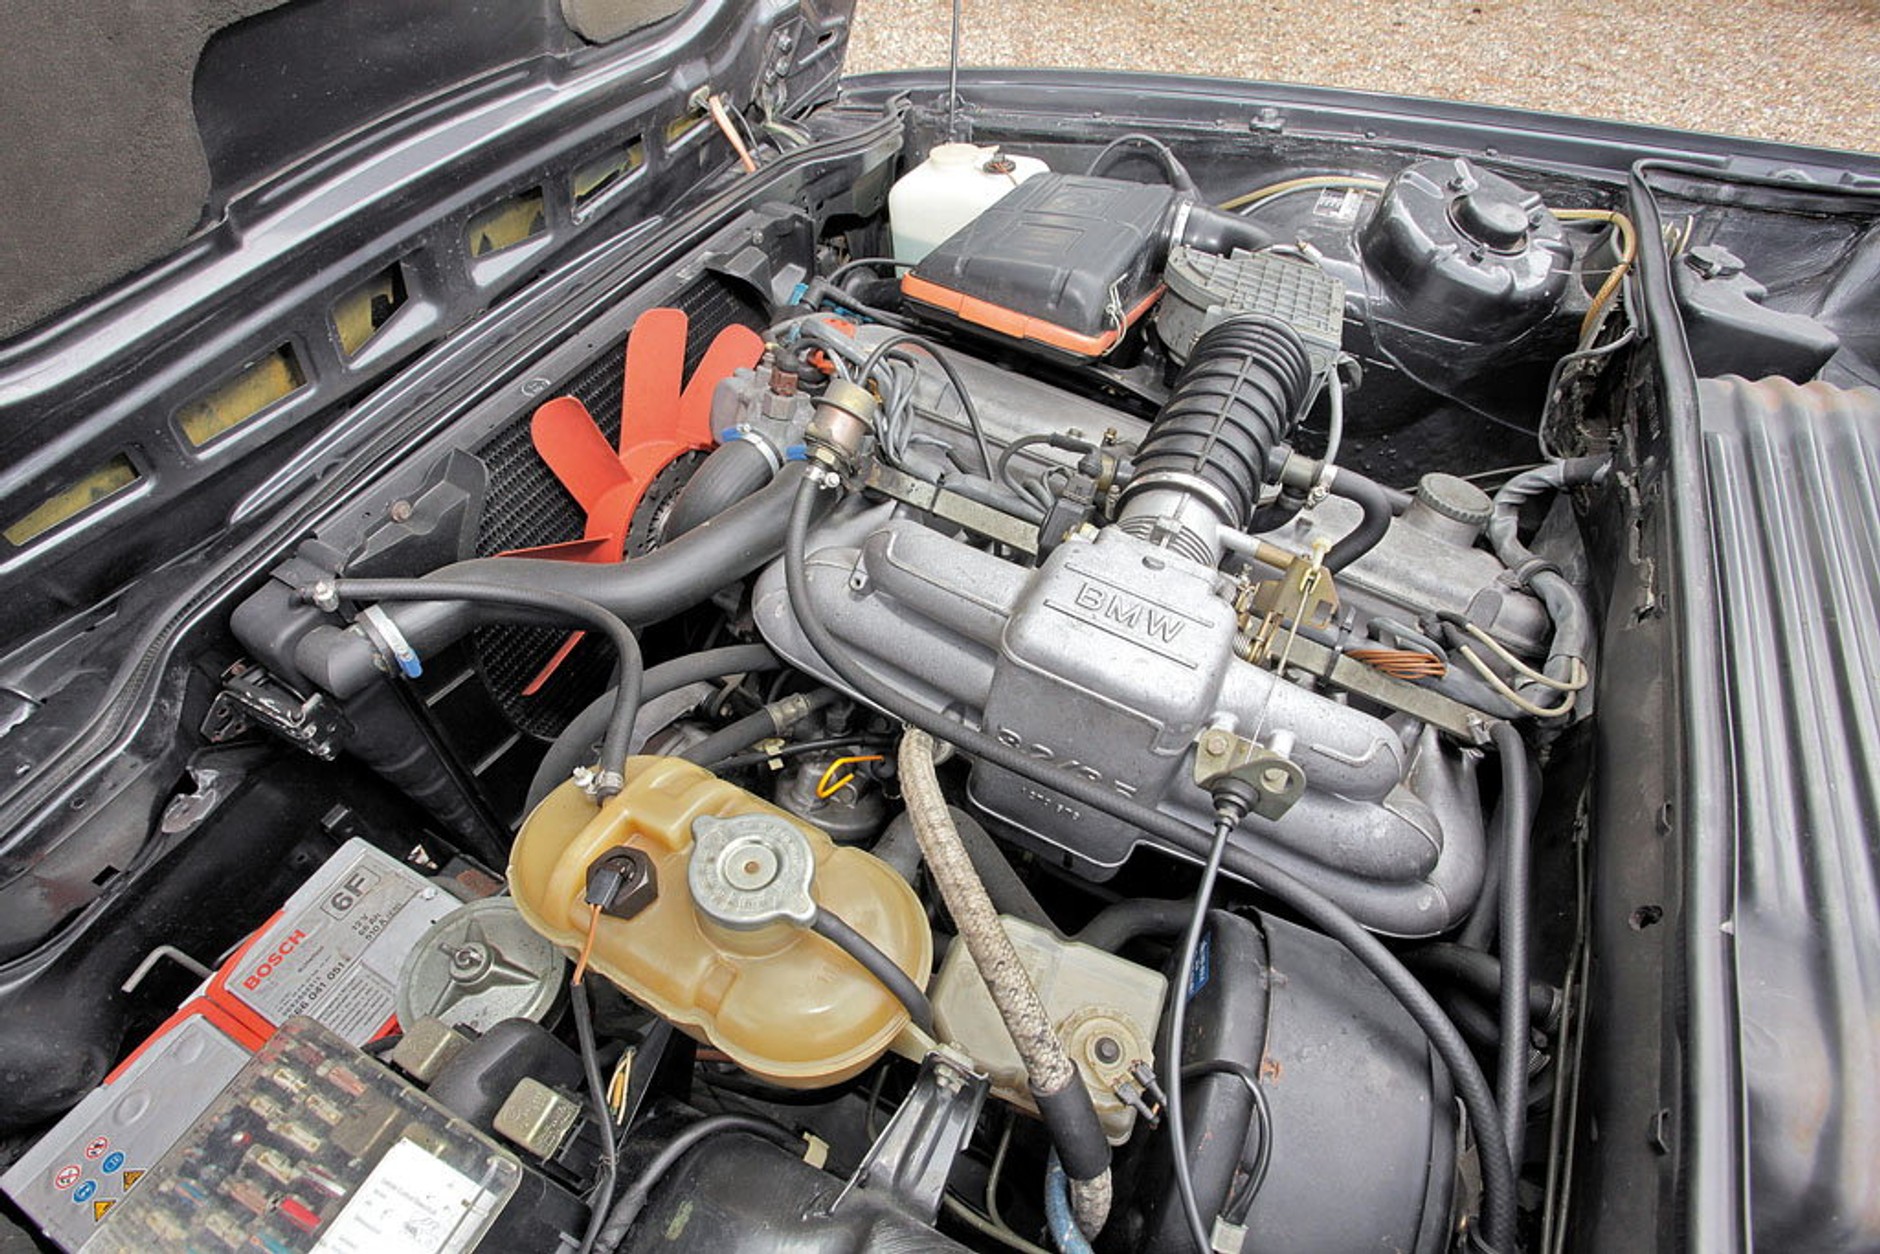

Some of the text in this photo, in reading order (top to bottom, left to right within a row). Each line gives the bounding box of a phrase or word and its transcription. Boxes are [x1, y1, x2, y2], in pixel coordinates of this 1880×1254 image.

[1075, 582, 1185, 643] BMW
[331, 873, 365, 911] 6F
[242, 929, 307, 991] BOSCH
[326, 961, 345, 981] 051
